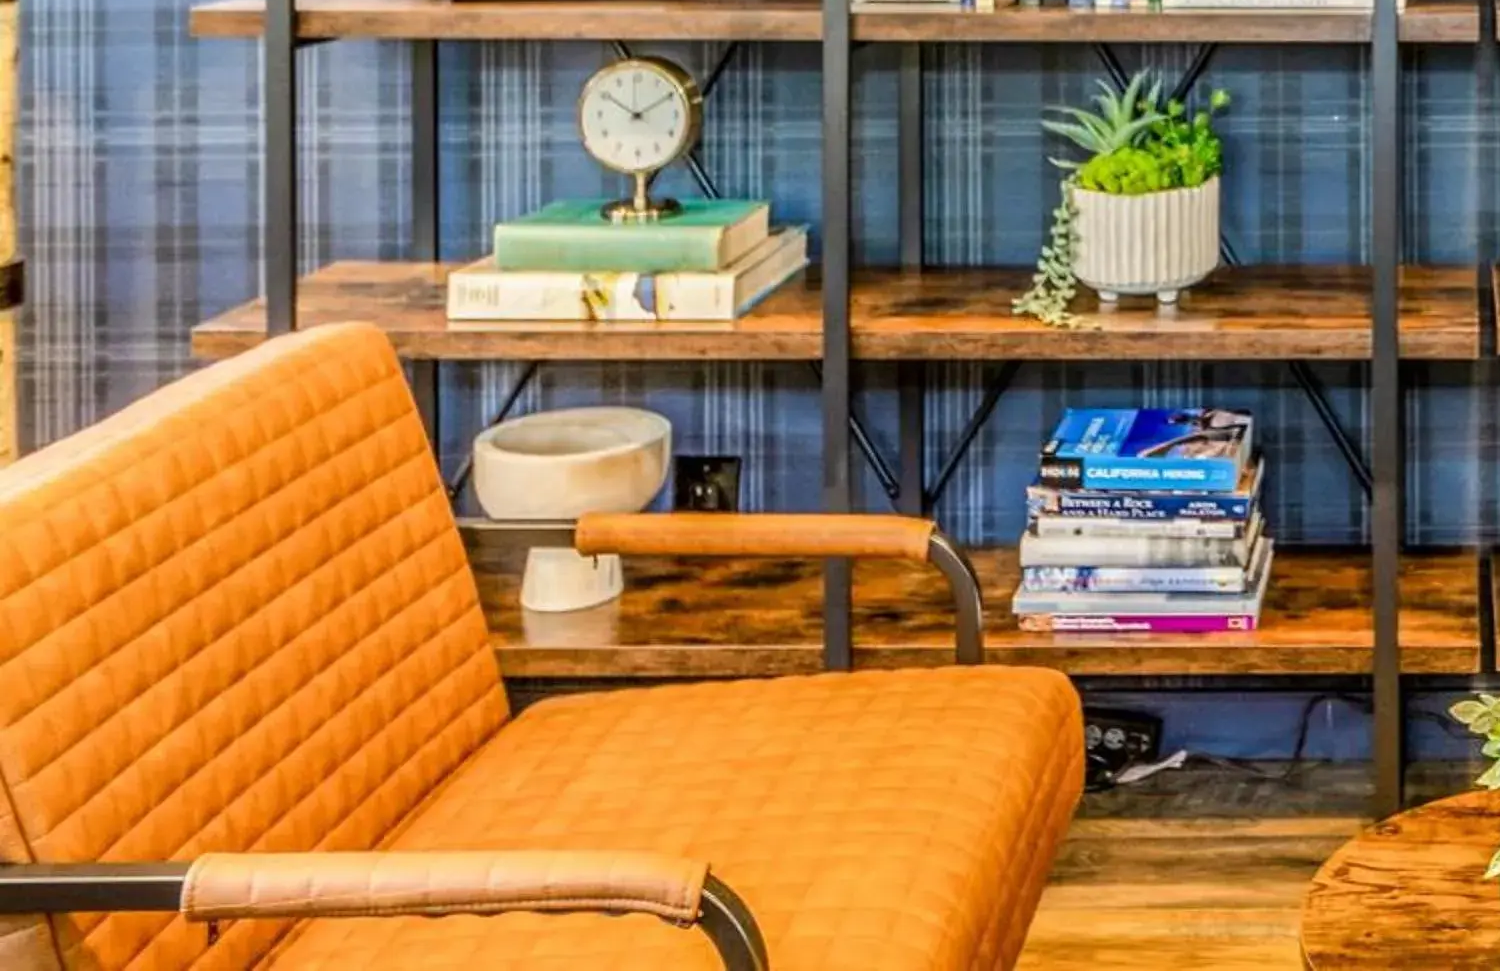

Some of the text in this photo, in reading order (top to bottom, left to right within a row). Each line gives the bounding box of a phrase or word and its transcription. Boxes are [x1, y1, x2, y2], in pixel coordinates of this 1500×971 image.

[1086, 467, 1160, 479] CALIFORNIA
[1162, 467, 1206, 480] HIKING
[1061, 497, 1112, 509] BETWEEN
[1123, 497, 1154, 509] ROCK
